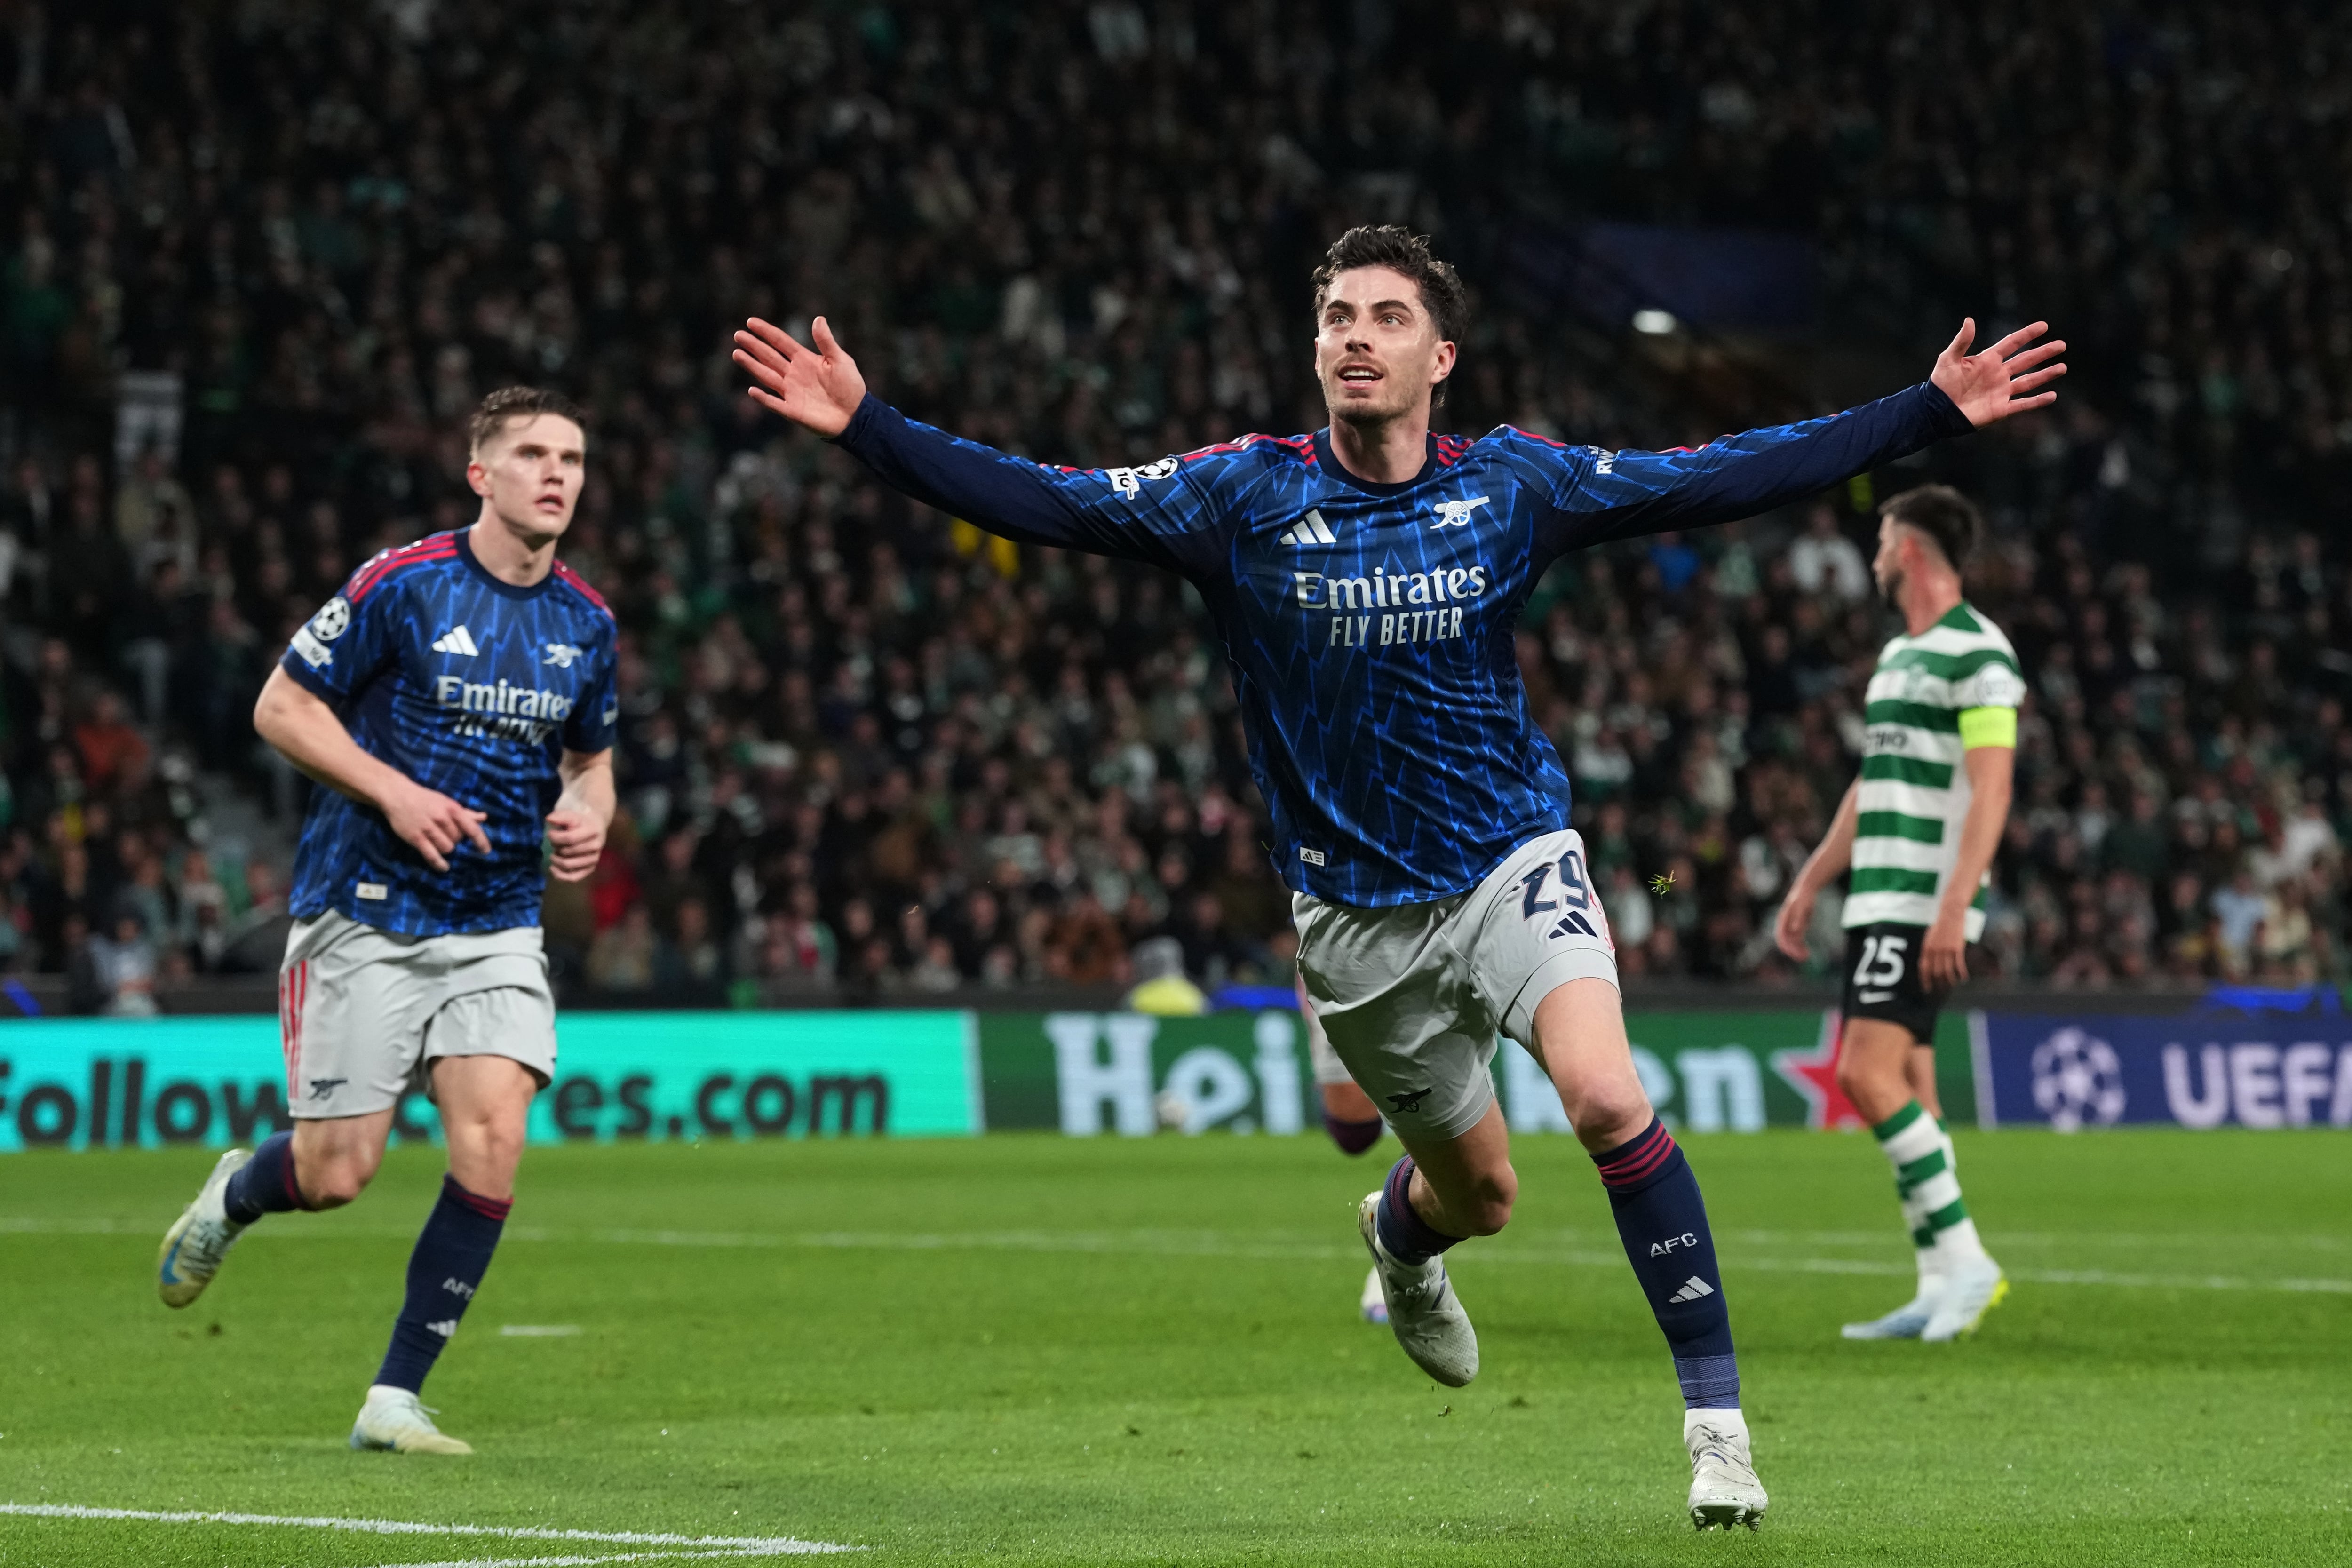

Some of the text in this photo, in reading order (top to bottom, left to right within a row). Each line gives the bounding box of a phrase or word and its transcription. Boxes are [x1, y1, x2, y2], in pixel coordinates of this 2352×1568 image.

[1294, 565, 1485, 610] Emirates
[1330, 607, 1462, 646] FLY BETTER
[1521, 850, 1591, 922] 29
[1852, 935, 1908, 987] 25
[1650, 1232, 1698, 1258] AFC
